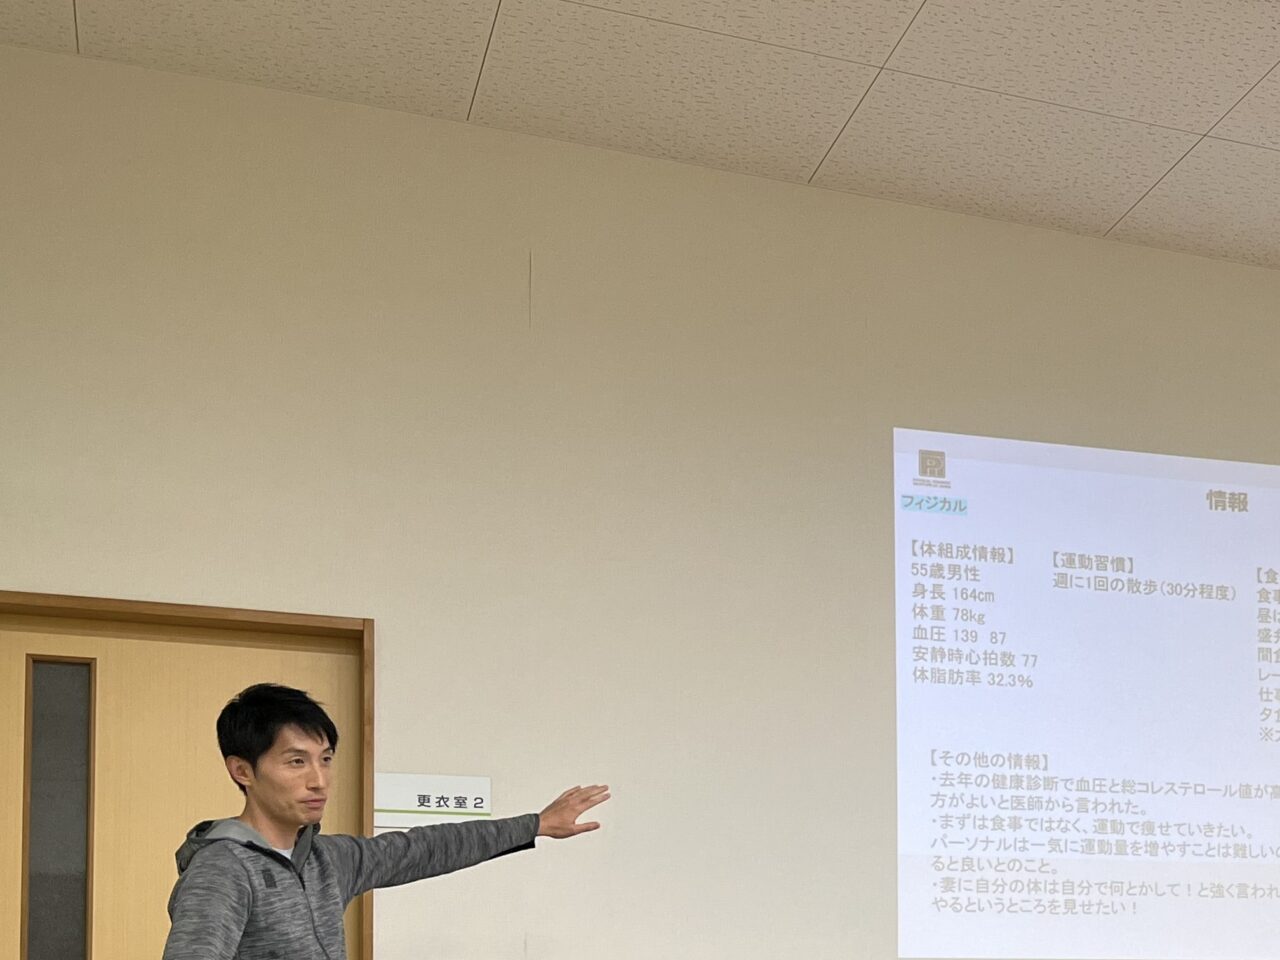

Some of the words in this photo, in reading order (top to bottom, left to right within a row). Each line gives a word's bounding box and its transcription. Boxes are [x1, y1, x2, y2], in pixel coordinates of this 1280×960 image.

[901, 495, 967, 512] フィジカル
[1206, 489, 1249, 513] 情報
[910, 539, 1015, 565] 【体組成情報】
[1051, 551, 1135, 574] 【運動習慣】
[910, 562, 981, 582] 55歳男性
[911, 583, 946, 601] 身長
[952, 587, 996, 603] 164cm
[911, 604, 946, 622] 体重
[952, 608, 986, 625] 78kg
[911, 625, 946, 643] 血圧
[953, 629, 978, 644] 139
[989, 631, 1006, 645] 87
[912, 645, 1017, 668] 安静時心拍数
[1021, 654, 1038, 668] 77
[912, 666, 982, 687] 体脂肪率
[987, 672, 1034, 689] 32.3%
[930, 749, 1049, 771] 【その他の情報】
[416, 794, 485, 809] 更衣室2
[930, 791, 1148, 816] 方がよいと医師から言われた。
[931, 855, 1059, 875] ると良いとのこと。
